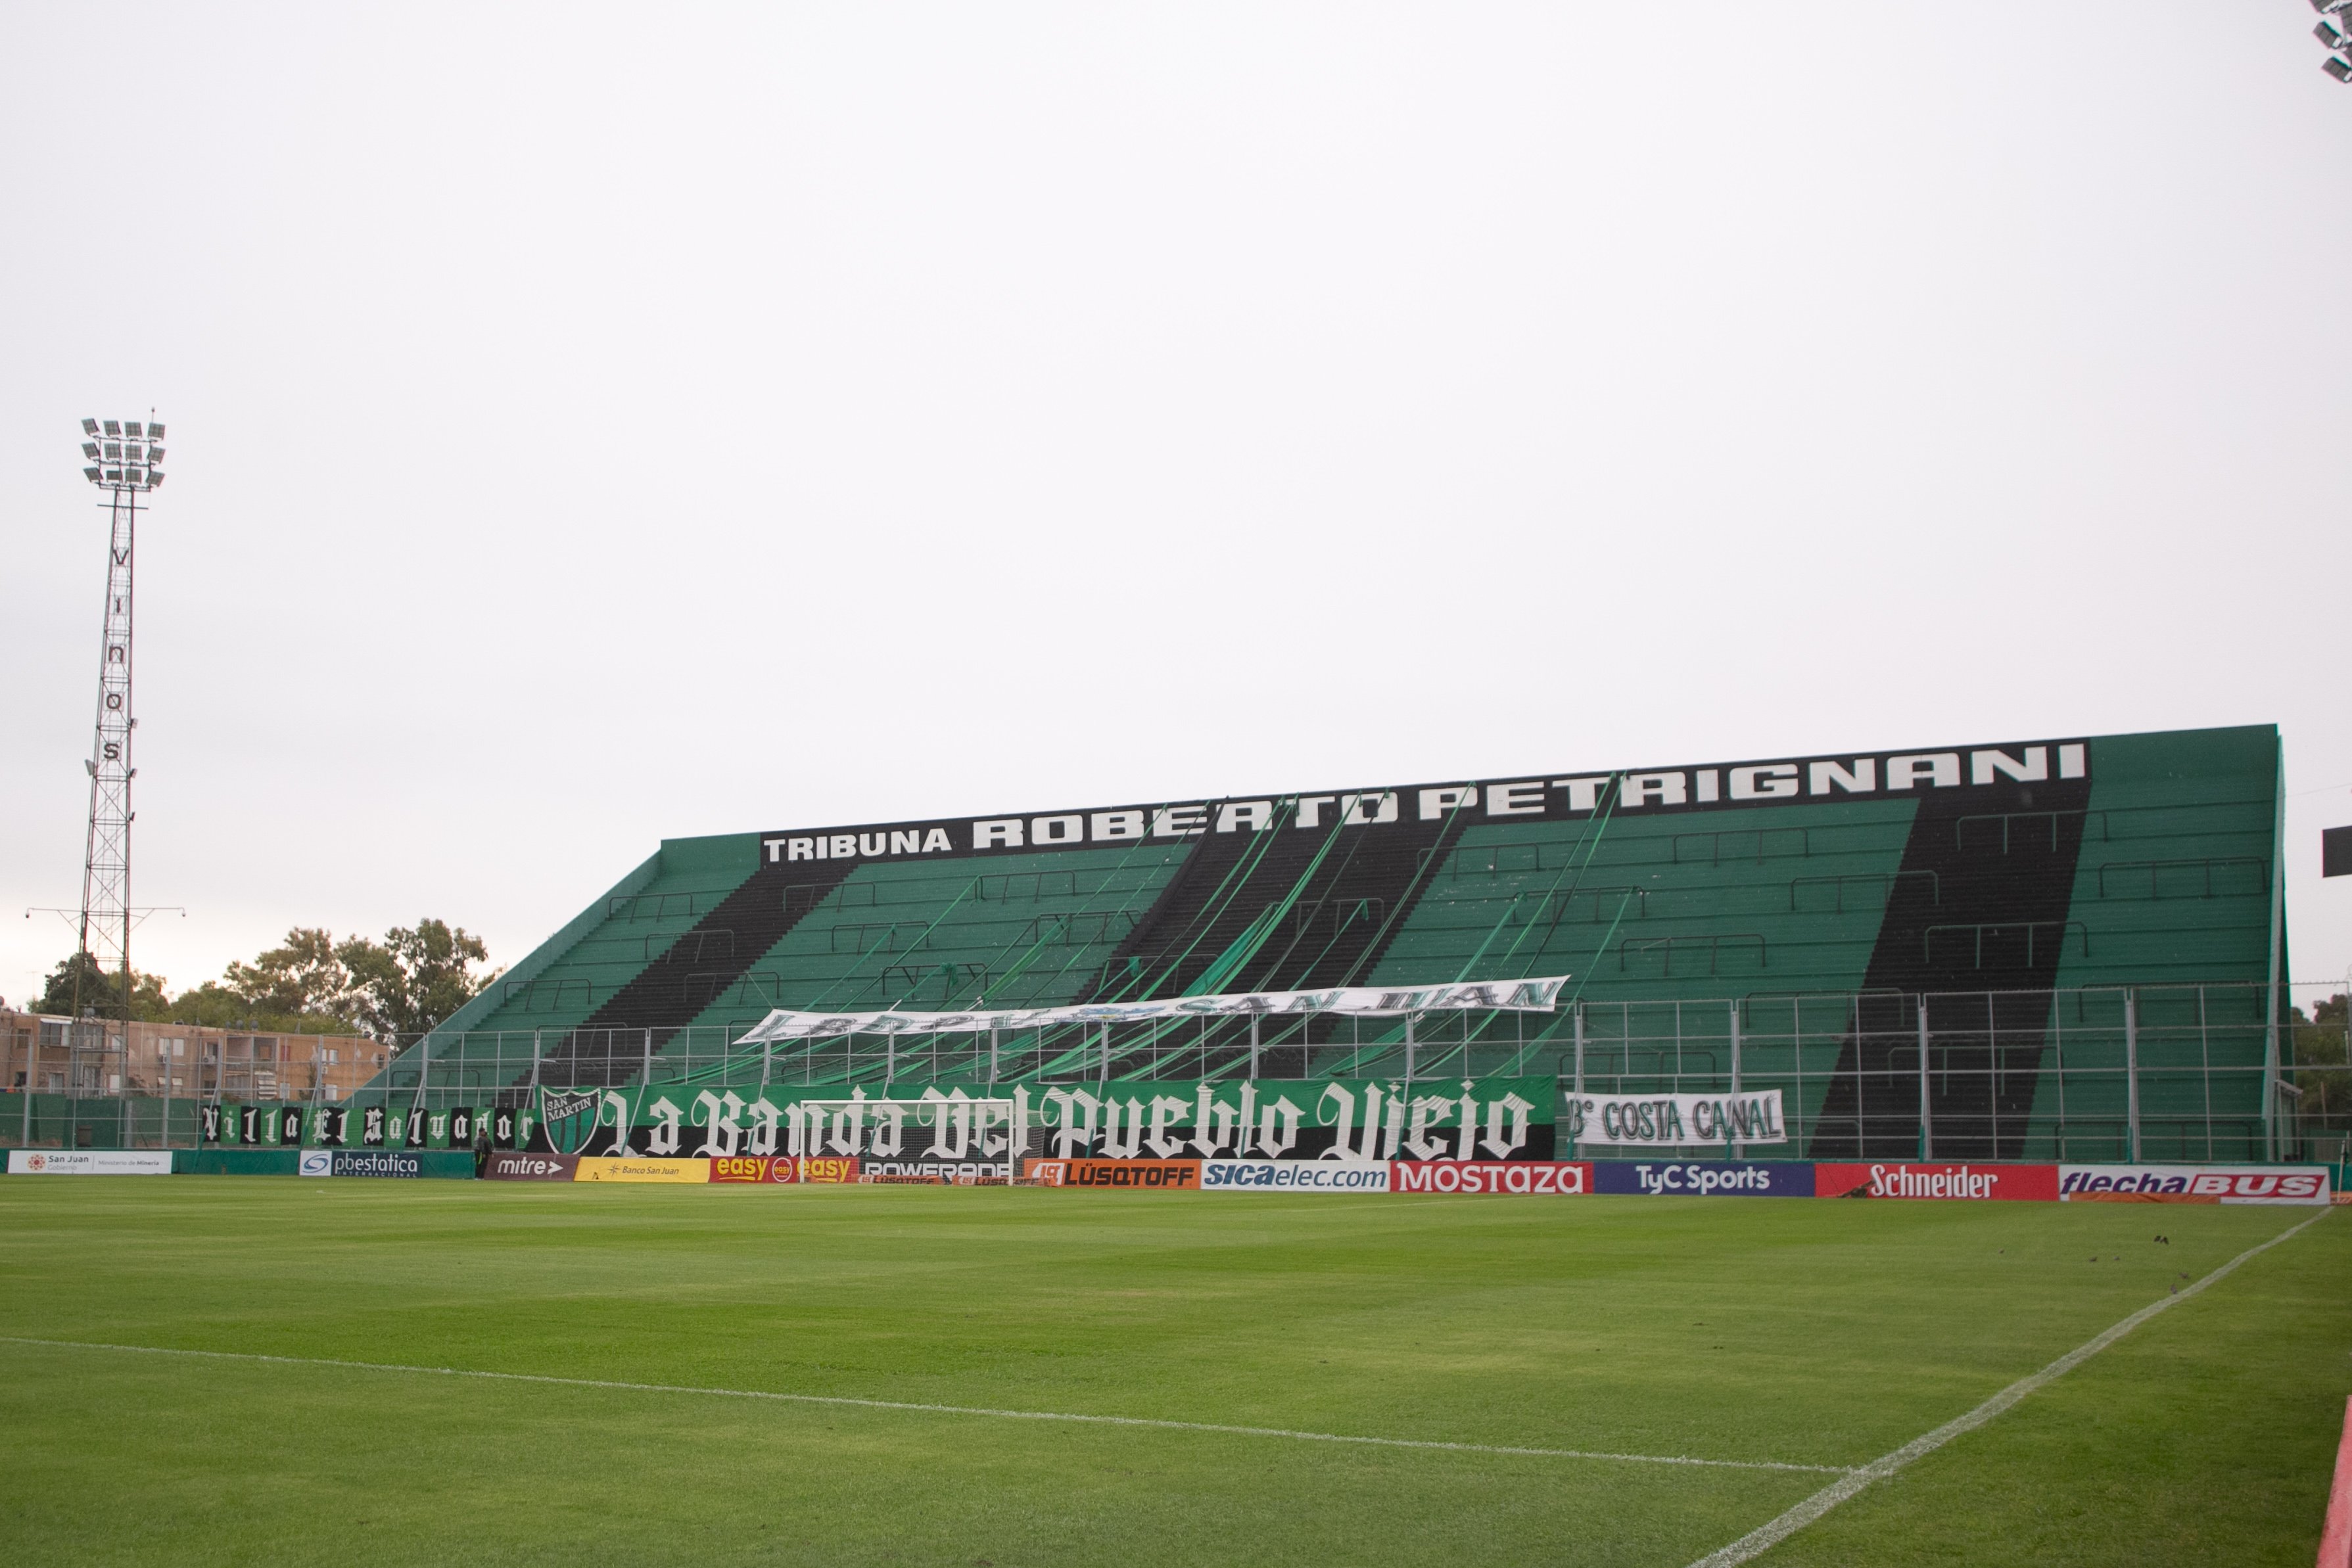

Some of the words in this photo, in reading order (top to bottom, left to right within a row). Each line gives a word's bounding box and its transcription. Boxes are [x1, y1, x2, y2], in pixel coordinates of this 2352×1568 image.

[763, 827, 953, 862] TRIBUNA
[973, 791, 1398, 849] ROBERTO
[1419, 744, 2086, 820] PETRIGNANI
[546, 1096, 568, 1111] SAN
[547, 1097, 592, 1122] MARTIN
[202, 1107, 298, 1143] Villa
[312, 1109, 350, 1143] El
[600, 1090, 684, 1158] La
[691, 1084, 909, 1159] Banda
[917, 1083, 1033, 1159] Del
[1040, 1080, 1306, 1160] Pueblo
[1316, 1079, 1536, 1161] Viejo
[1603, 1099, 1685, 1140] COSTA
[1693, 1095, 1782, 1140] CANAL
[335, 1153, 418, 1174] pbestatica
[497, 1156, 546, 1175] mitre
[622, 1166, 646, 1175] Banco
[646, 1166, 663, 1175] San
[663, 1167, 680, 1176] Juan
[717, 1158, 768, 1181] easy
[774, 1166, 790, 1174] easy
[797, 1159, 851, 1183] easy
[1064, 1163, 1194, 1186] LÜSQTOFF
[1635, 1164, 1683, 1195] TyC
[1686, 1164, 1770, 1195] Sports
[1870, 1164, 1998, 1198] Schneider
